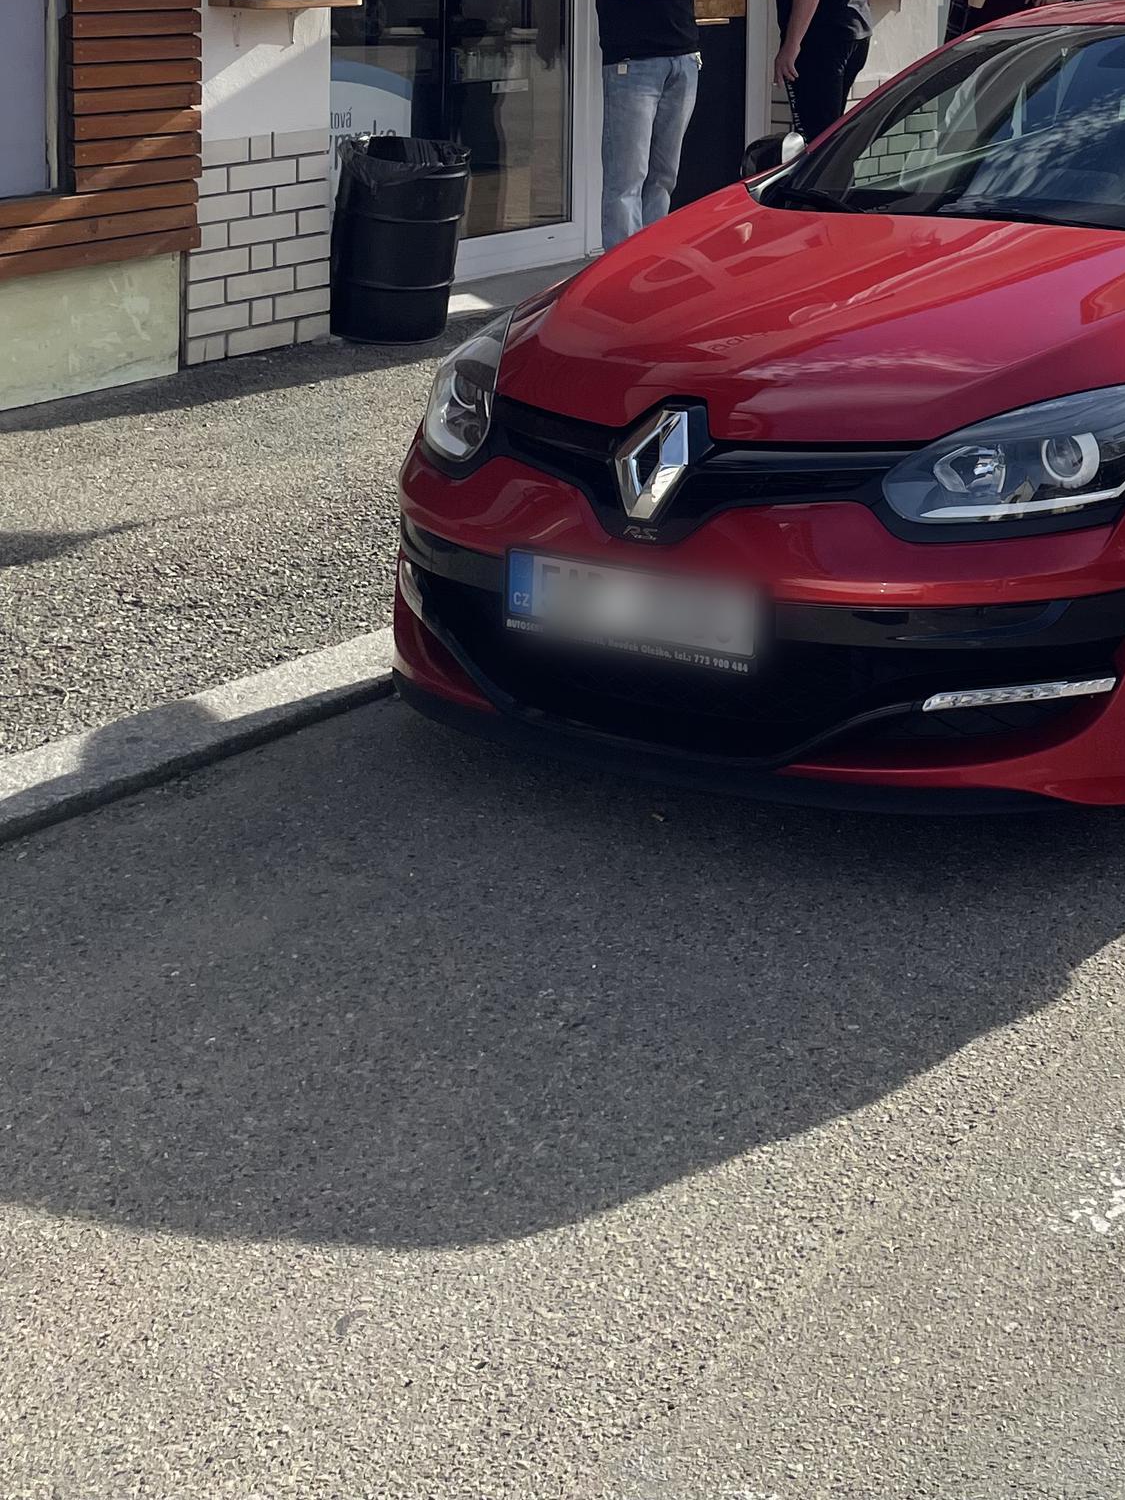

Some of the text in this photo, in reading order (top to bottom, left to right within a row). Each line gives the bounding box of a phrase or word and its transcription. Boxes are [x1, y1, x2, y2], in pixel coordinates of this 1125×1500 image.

[331, 106, 353, 130] tová
[513, 591, 530, 607] CZ
[694, 653, 710, 665] 773
